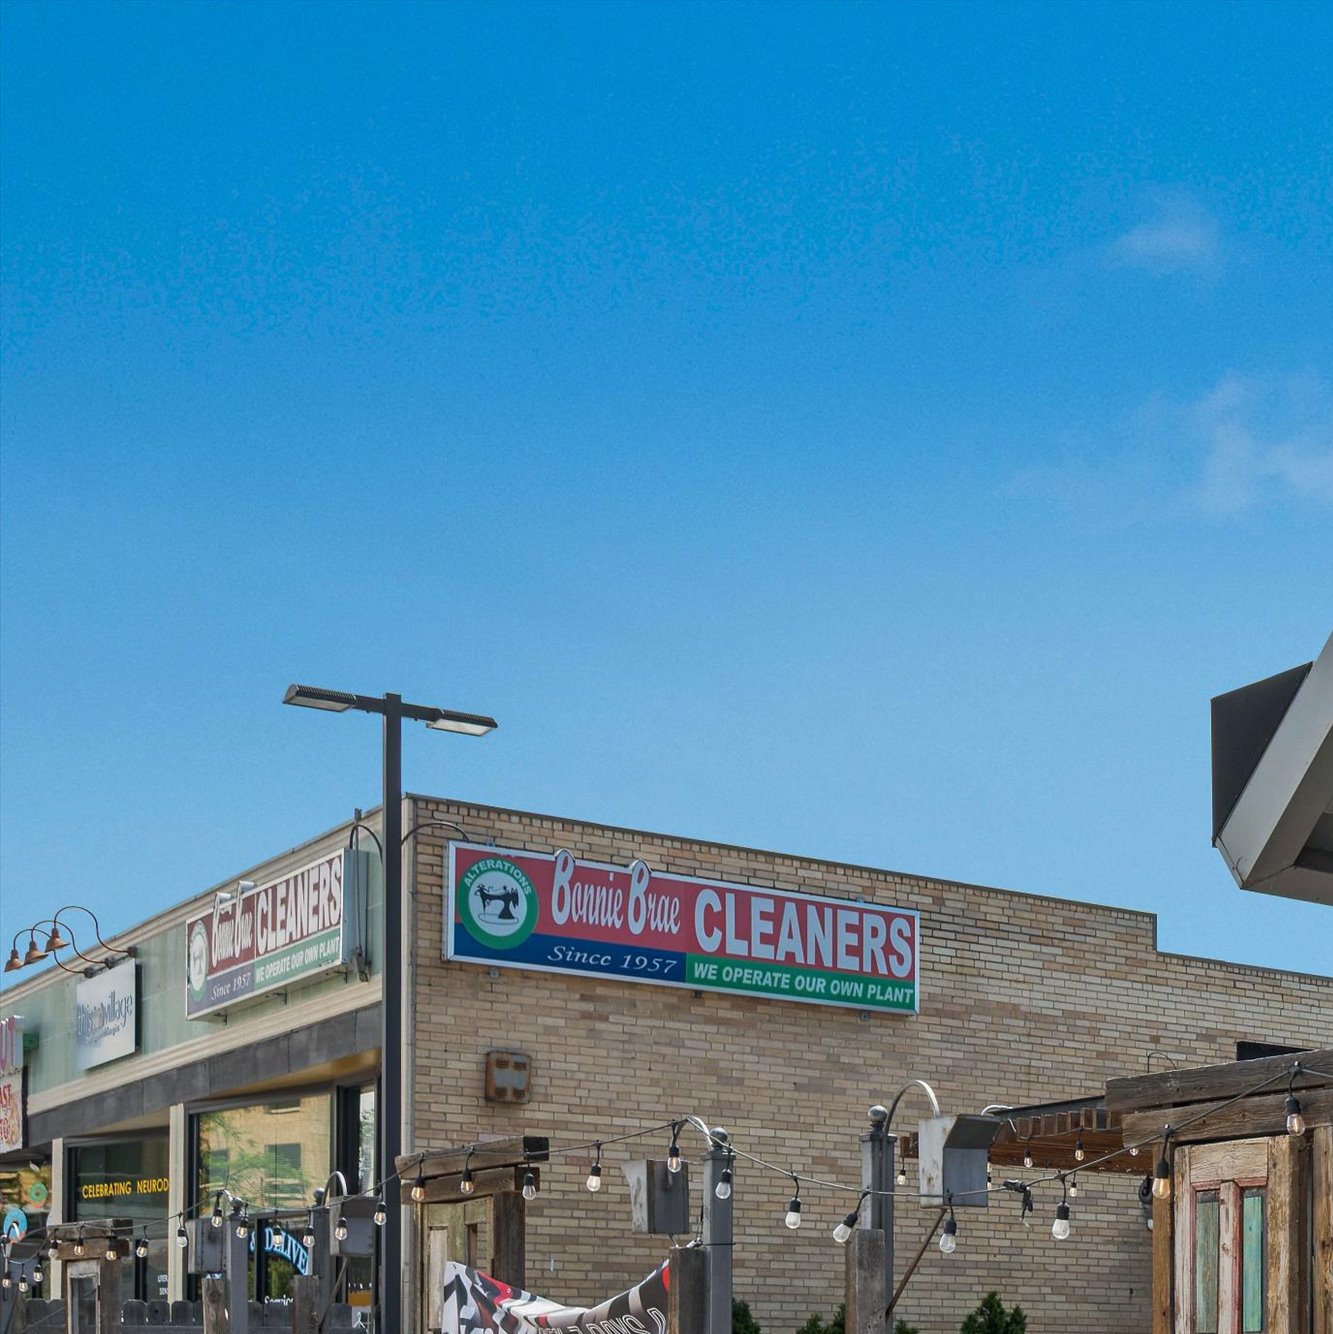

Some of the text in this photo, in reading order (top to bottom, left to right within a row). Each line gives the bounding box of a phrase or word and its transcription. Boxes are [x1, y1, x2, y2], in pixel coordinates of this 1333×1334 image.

[464, 858, 532, 896] ALTERATIONS
[552, 849, 680, 936] Bonnie Brae
[257, 856, 342, 955] CLEANERS
[694, 888, 913, 978] CLEANERS
[265, 956, 290, 981] OPERATE
[291, 949, 304, 969] OUR
[305, 945, 318, 965] OWN
[319, 936, 340, 957] PLANT
[547, 946, 678, 974] Since 1957
[212, 972, 251, 1000] Since 1957
[694, 962, 914, 1004] WE OPERATE OUR OWN PLANT
[82, 1180, 132, 1199] CELEBRATING
